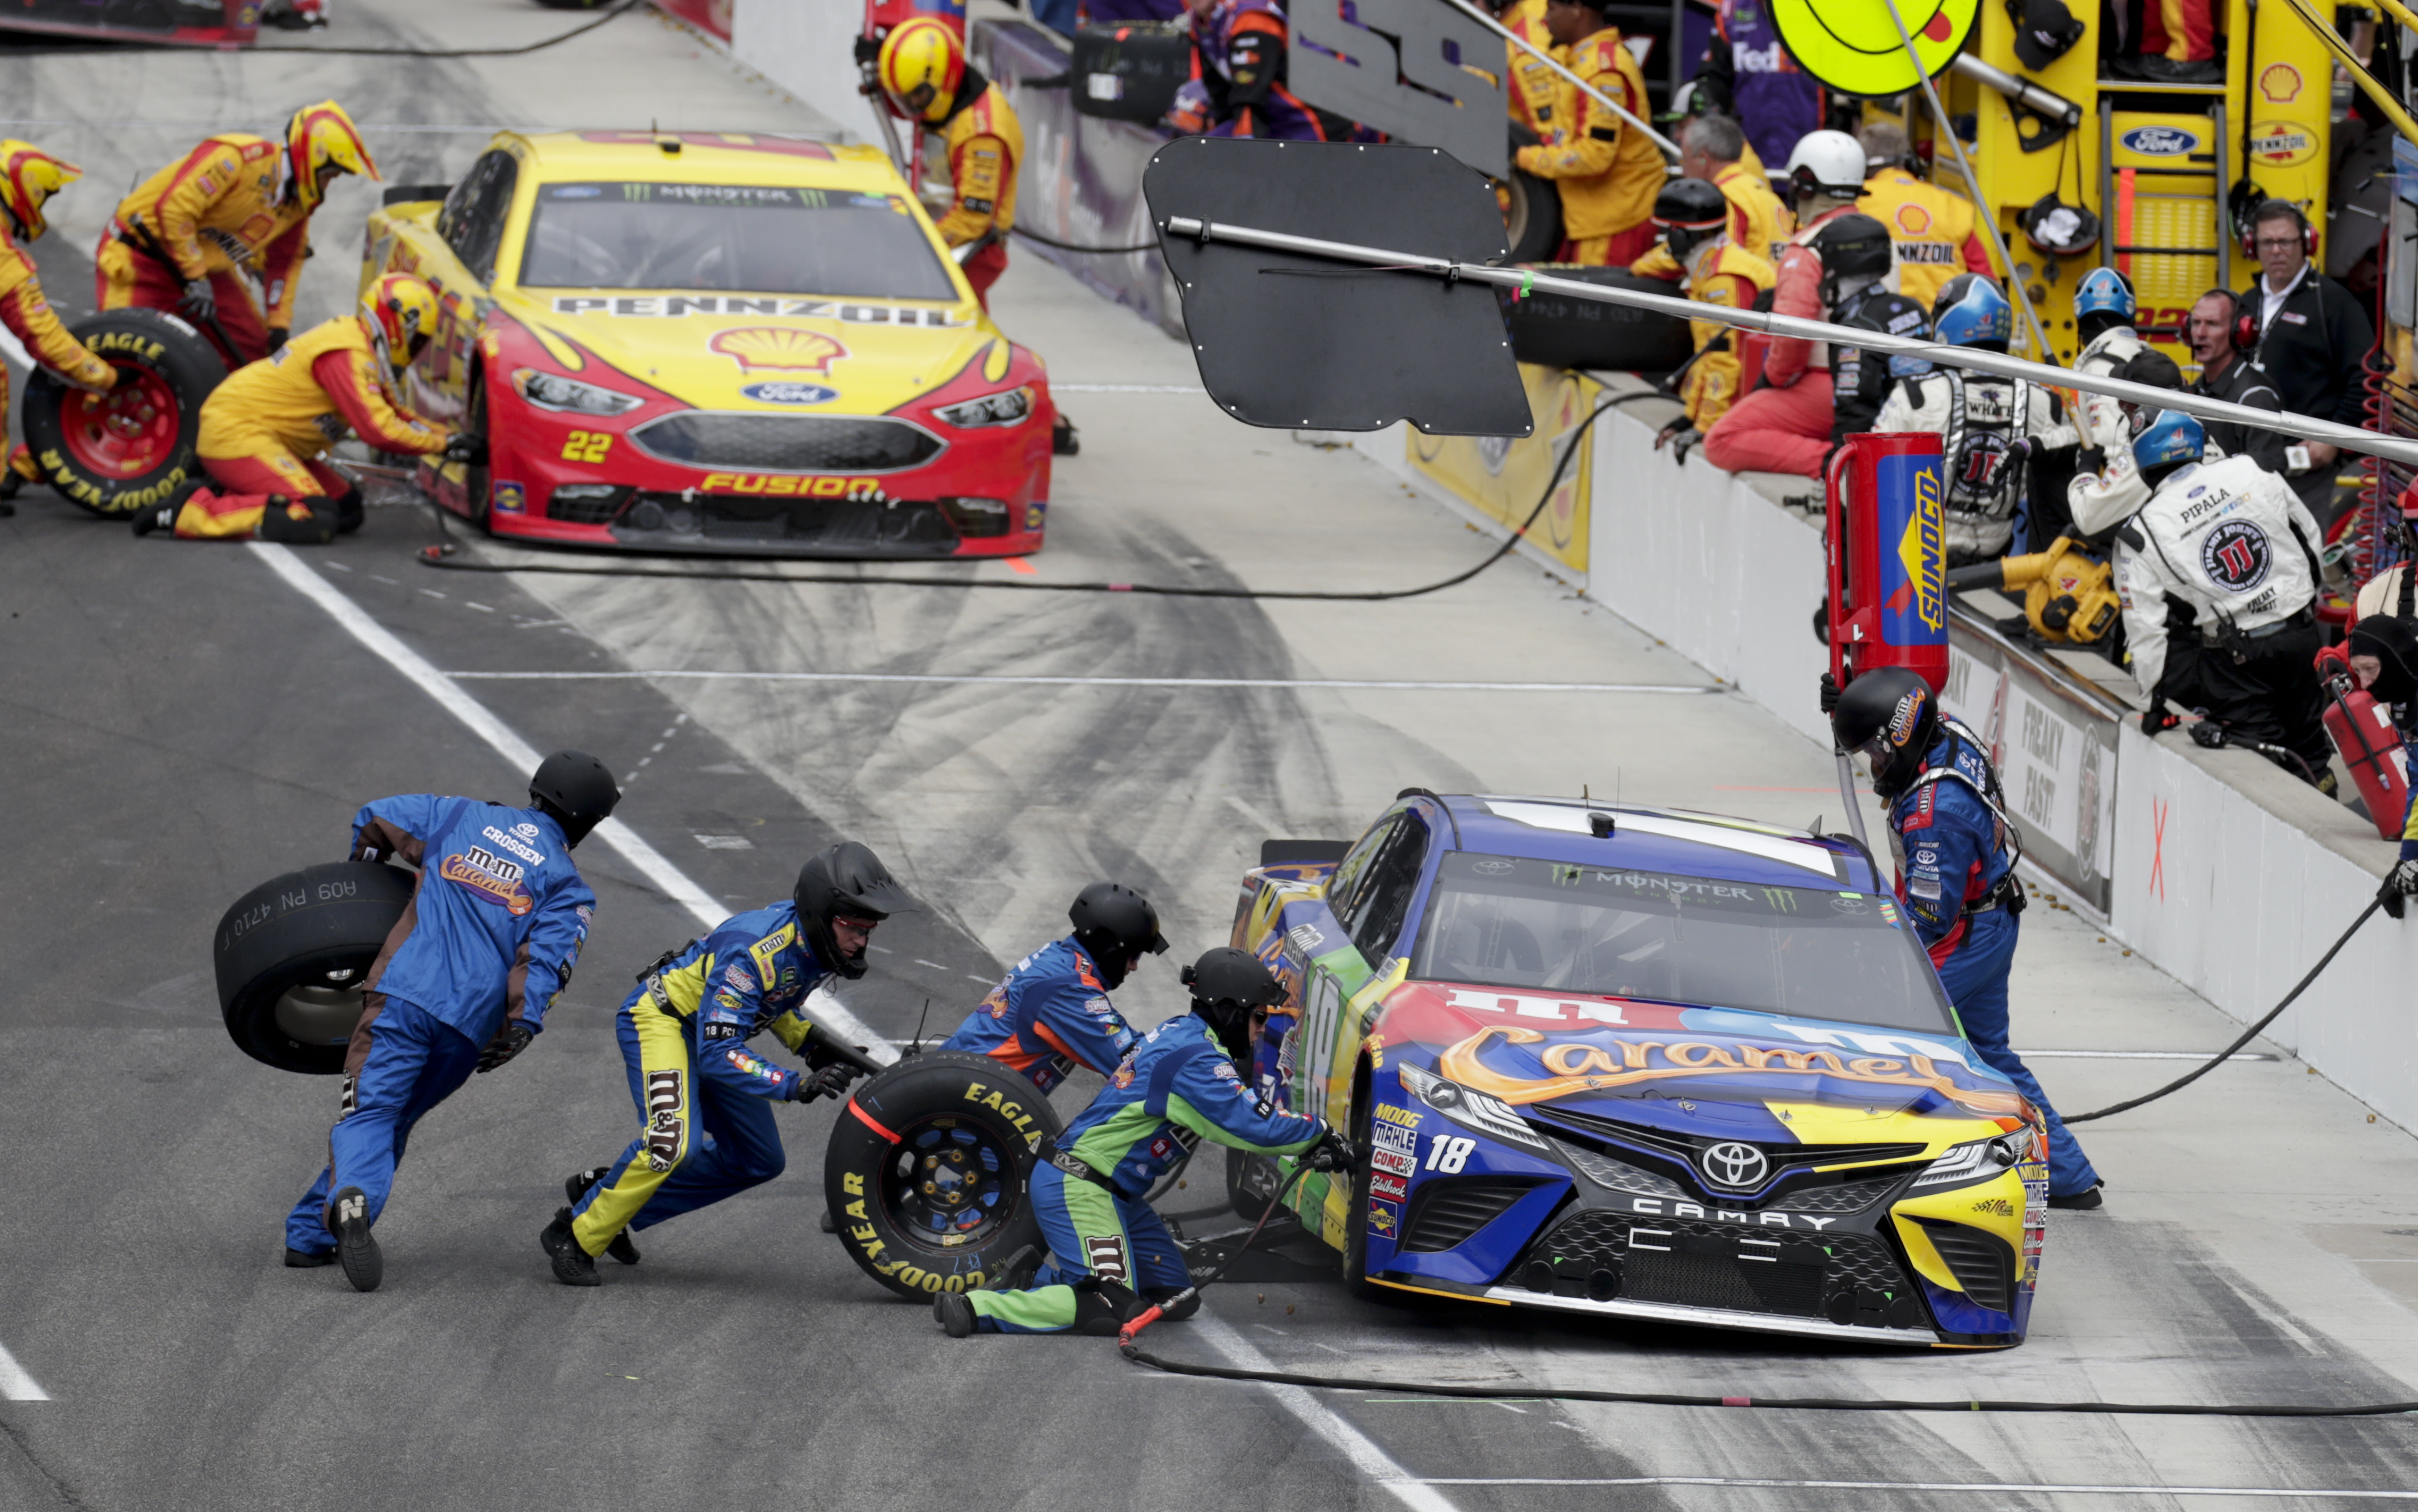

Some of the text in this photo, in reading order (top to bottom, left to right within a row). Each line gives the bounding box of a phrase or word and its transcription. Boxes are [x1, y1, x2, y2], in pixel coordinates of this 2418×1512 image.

[2135, 129, 2184, 151] Ford
[660, 184, 792, 201] MONSTER
[1898, 244, 1954, 263] NNZOIL
[552, 296, 976, 328] PENNZOIL
[86, 332, 166, 360] EAGLE
[758, 382, 820, 403] Ford
[561, 431, 613, 463] 22
[700, 472, 880, 497] FUSION
[2181, 488, 2231, 524] PIPALA
[1919, 475, 1942, 626] SUNOCO
[2205, 534, 2223, 569] JIMMY
[2217, 536, 2254, 580] JJ
[2022, 700, 2064, 772] FREAKY
[2024, 765, 2056, 831] FAST!
[482, 826, 546, 866] CROSSEN
[508, 826, 535, 846] TOYOTA
[440, 853, 523, 899] Caramel
[1915, 864, 1939, 873] TOYOTA
[281, 888, 306, 910] PN
[318, 881, 356, 900] A09
[1597, 872, 1755, 901] MONSTER
[234, 903, 271, 937] 4710
[1915, 907, 1938, 922] STANLEY
[716, 995, 742, 1008] SUNOCO
[705, 1027, 735, 1037] 18 PC1
[1440, 1026, 1956, 1105] Caramel
[648, 1071, 683, 1172] m&m's
[1258, 1102, 1270, 1115] 18
[1373, 1102, 1424, 1128] MOOG
[1373, 1123, 1415, 1151] MAHLE
[1374, 1151, 1403, 1168] COMP
[1425, 1134, 1477, 1174] 18
[1370, 1175, 1406, 1198] Edelbrock
[2018, 1164, 2049, 1181] MOOG
[1369, 1214, 1394, 1225] SUNOCO
[1633, 1198, 1836, 1232] CAMRY
[843, 1172, 986, 1294] GOODYEAR
